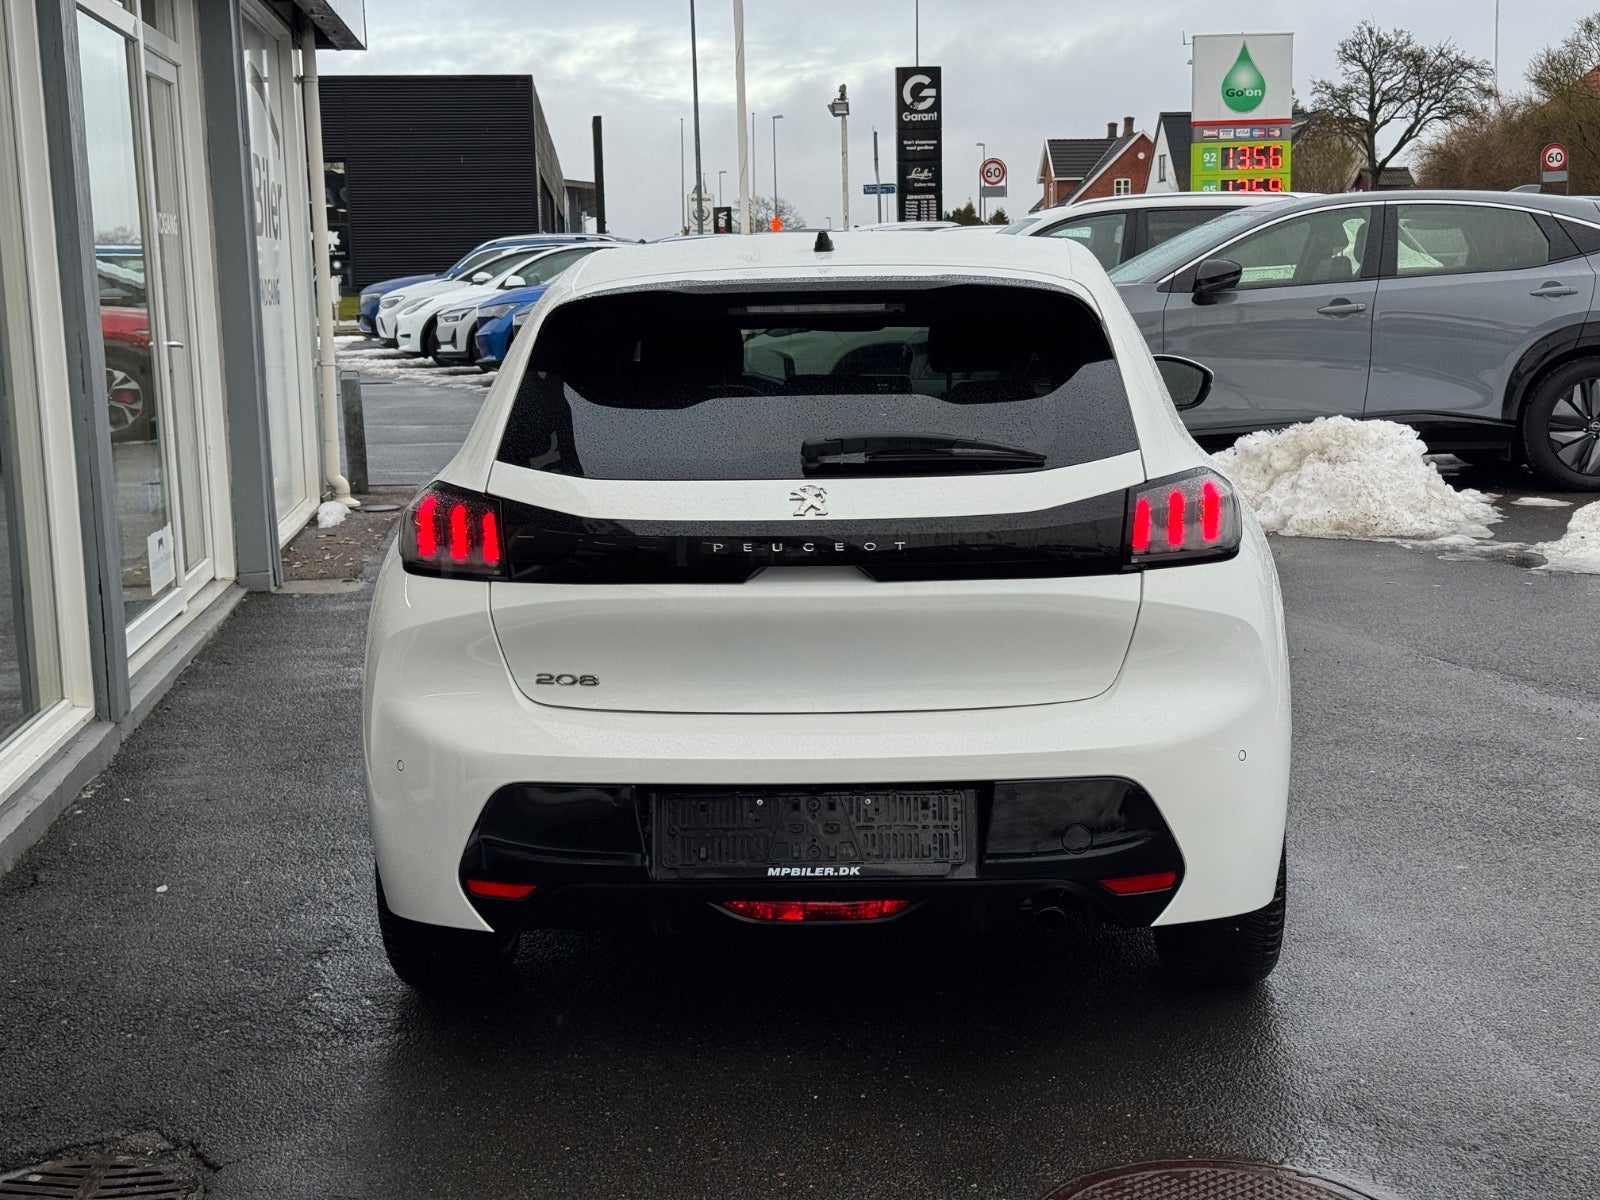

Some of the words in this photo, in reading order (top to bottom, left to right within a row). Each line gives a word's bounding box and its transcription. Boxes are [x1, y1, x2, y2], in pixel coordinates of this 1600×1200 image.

[1226, 87, 1262, 97] Go'on
[902, 111, 938, 121] Garant
[1203, 152, 1217, 162] 92
[1228, 144, 1282, 170] 13.56
[1547, 152, 1563, 163] 60
[986, 167, 1001, 178] 60
[253, 152, 282, 241] Biler
[713, 541, 906, 553] PEUGEOT
[535, 673, 600, 687] 208
[767, 866, 861, 877] MPBILER.DK
